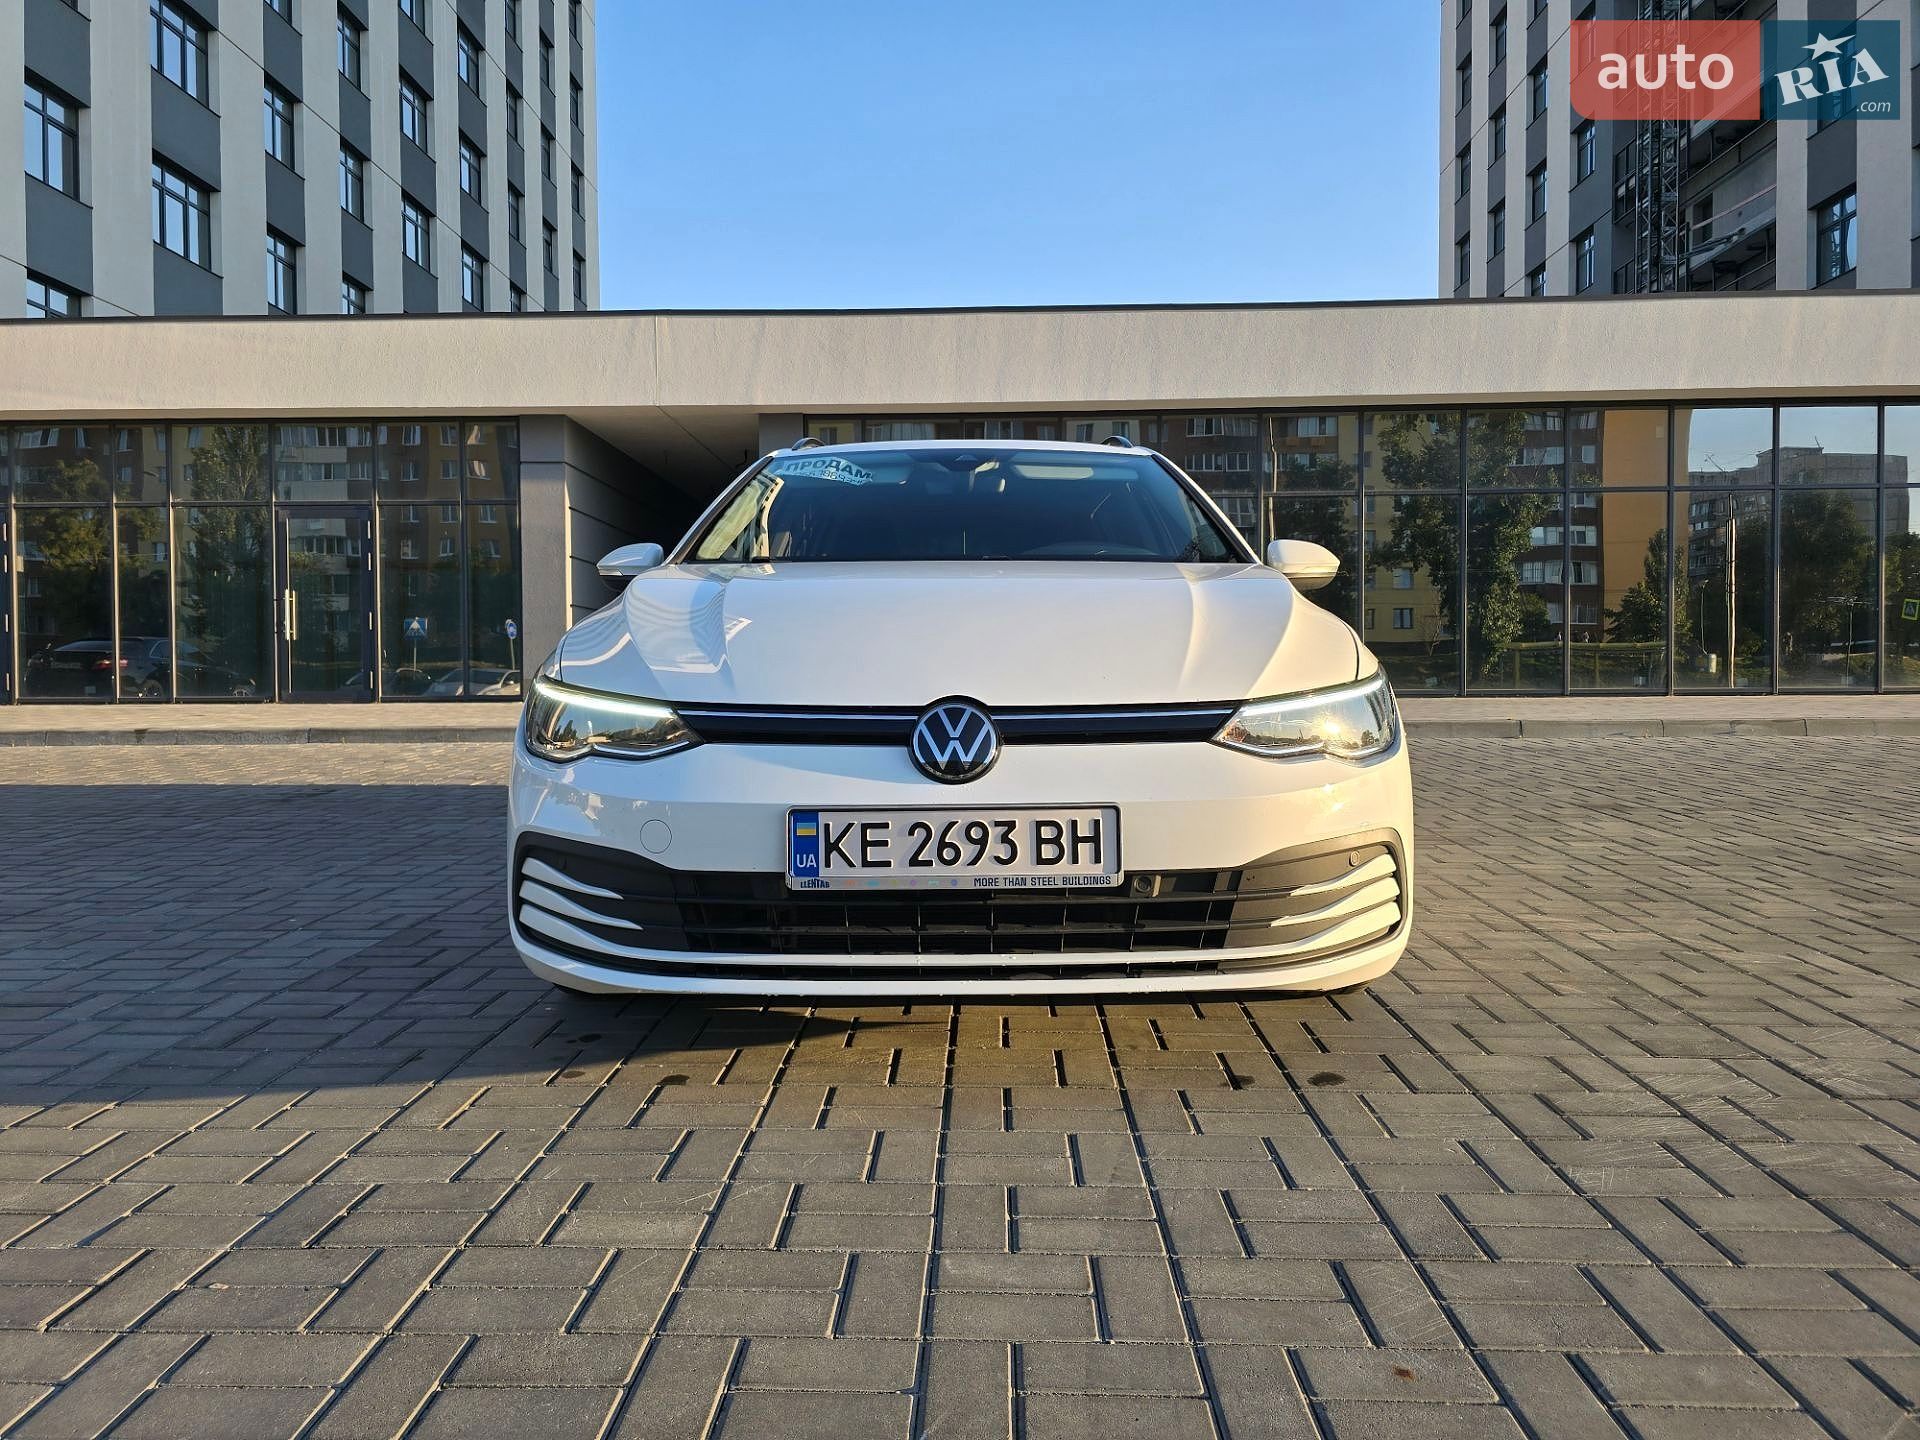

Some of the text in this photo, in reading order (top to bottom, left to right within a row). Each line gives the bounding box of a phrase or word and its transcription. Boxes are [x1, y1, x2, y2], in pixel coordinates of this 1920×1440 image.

[785, 459, 872, 480] ПРОДАМ
[823, 818, 1102, 868] KE 2693 BH
[796, 853, 817, 868] UA
[973, 875, 1112, 887] MORE THAN STEEL BUILDINGS
